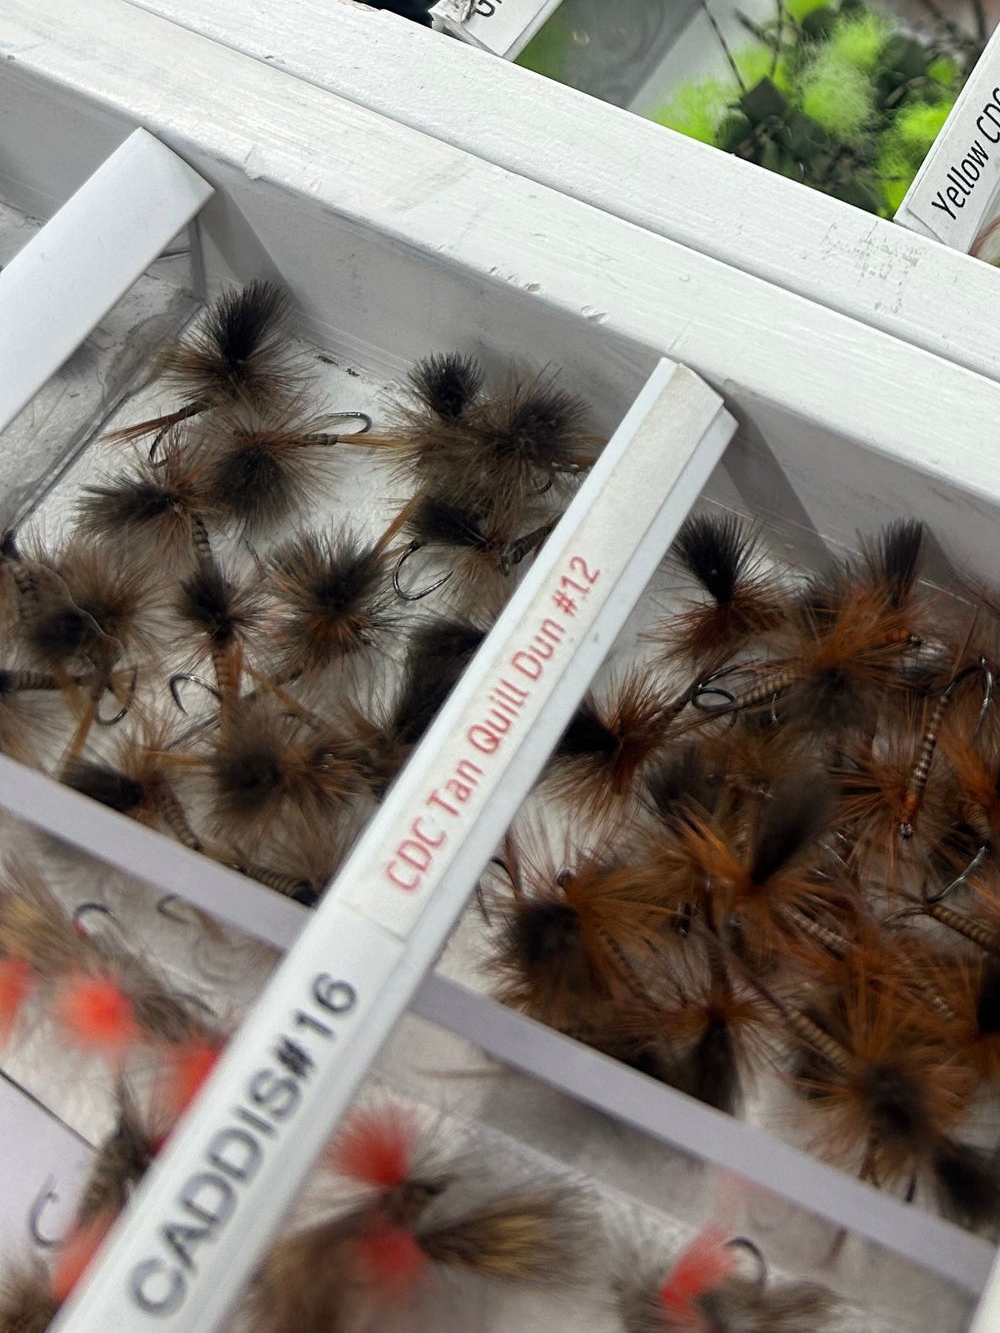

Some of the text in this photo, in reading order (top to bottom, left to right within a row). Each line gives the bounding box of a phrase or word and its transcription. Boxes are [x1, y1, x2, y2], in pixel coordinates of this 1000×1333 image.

[932, 138, 990, 221] Yellow
[384, 555, 601, 894] CDC Tan Quill Dun #12
[126, 972, 360, 1320] CADDIS#16
